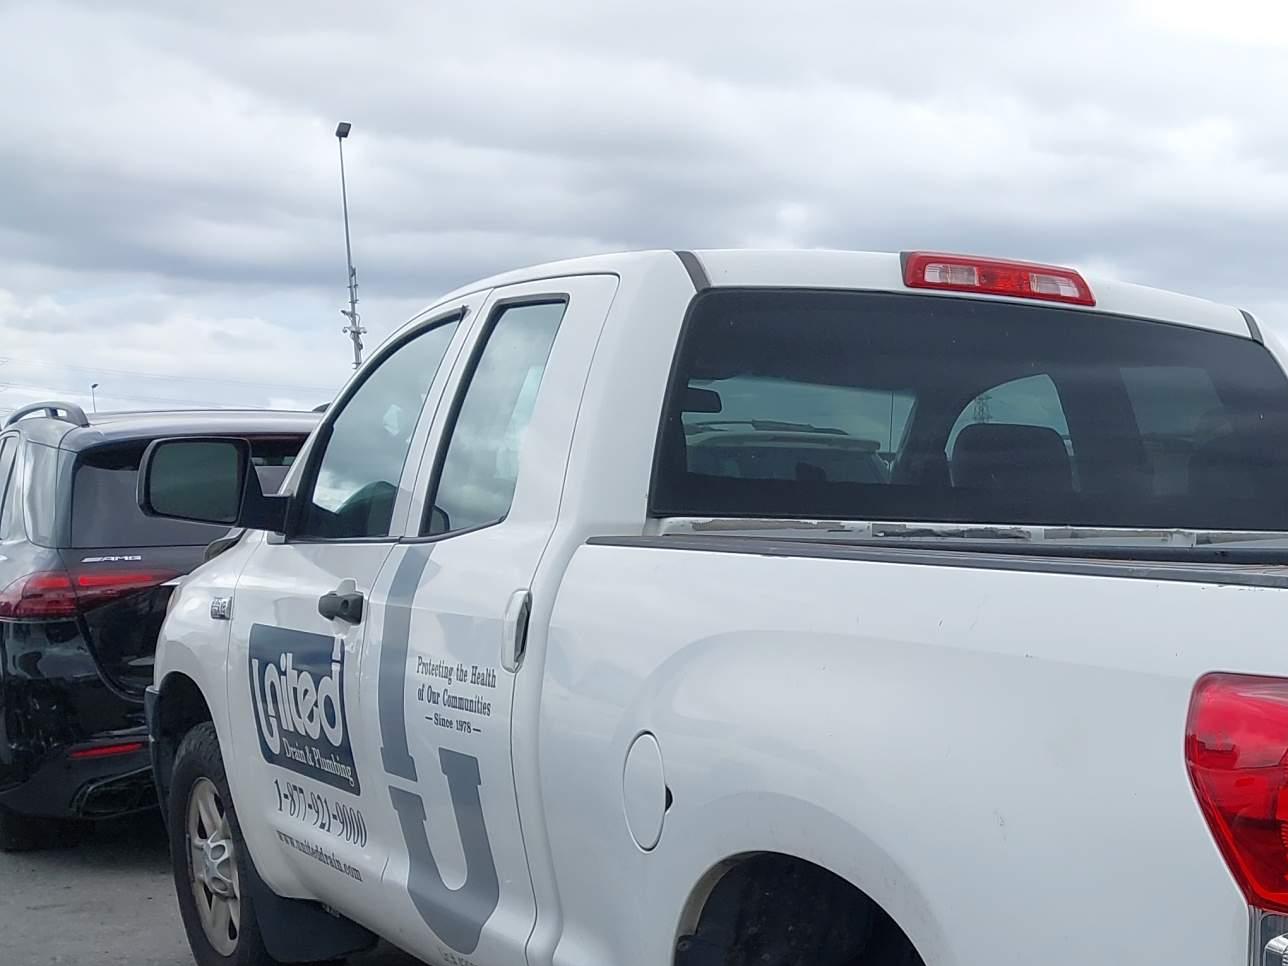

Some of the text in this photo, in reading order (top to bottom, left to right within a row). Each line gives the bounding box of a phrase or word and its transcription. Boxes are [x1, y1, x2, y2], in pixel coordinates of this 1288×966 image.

[252, 637, 344, 755] United
[416, 655, 496, 688] Protecting the Health
[417, 683, 491, 716] of Our Communities
[282, 738, 355, 786] Drain & Plumbing
[274, 779, 368, 848] 1-877-921-9000
[276, 830, 363, 881] www.uniteddrain.com
